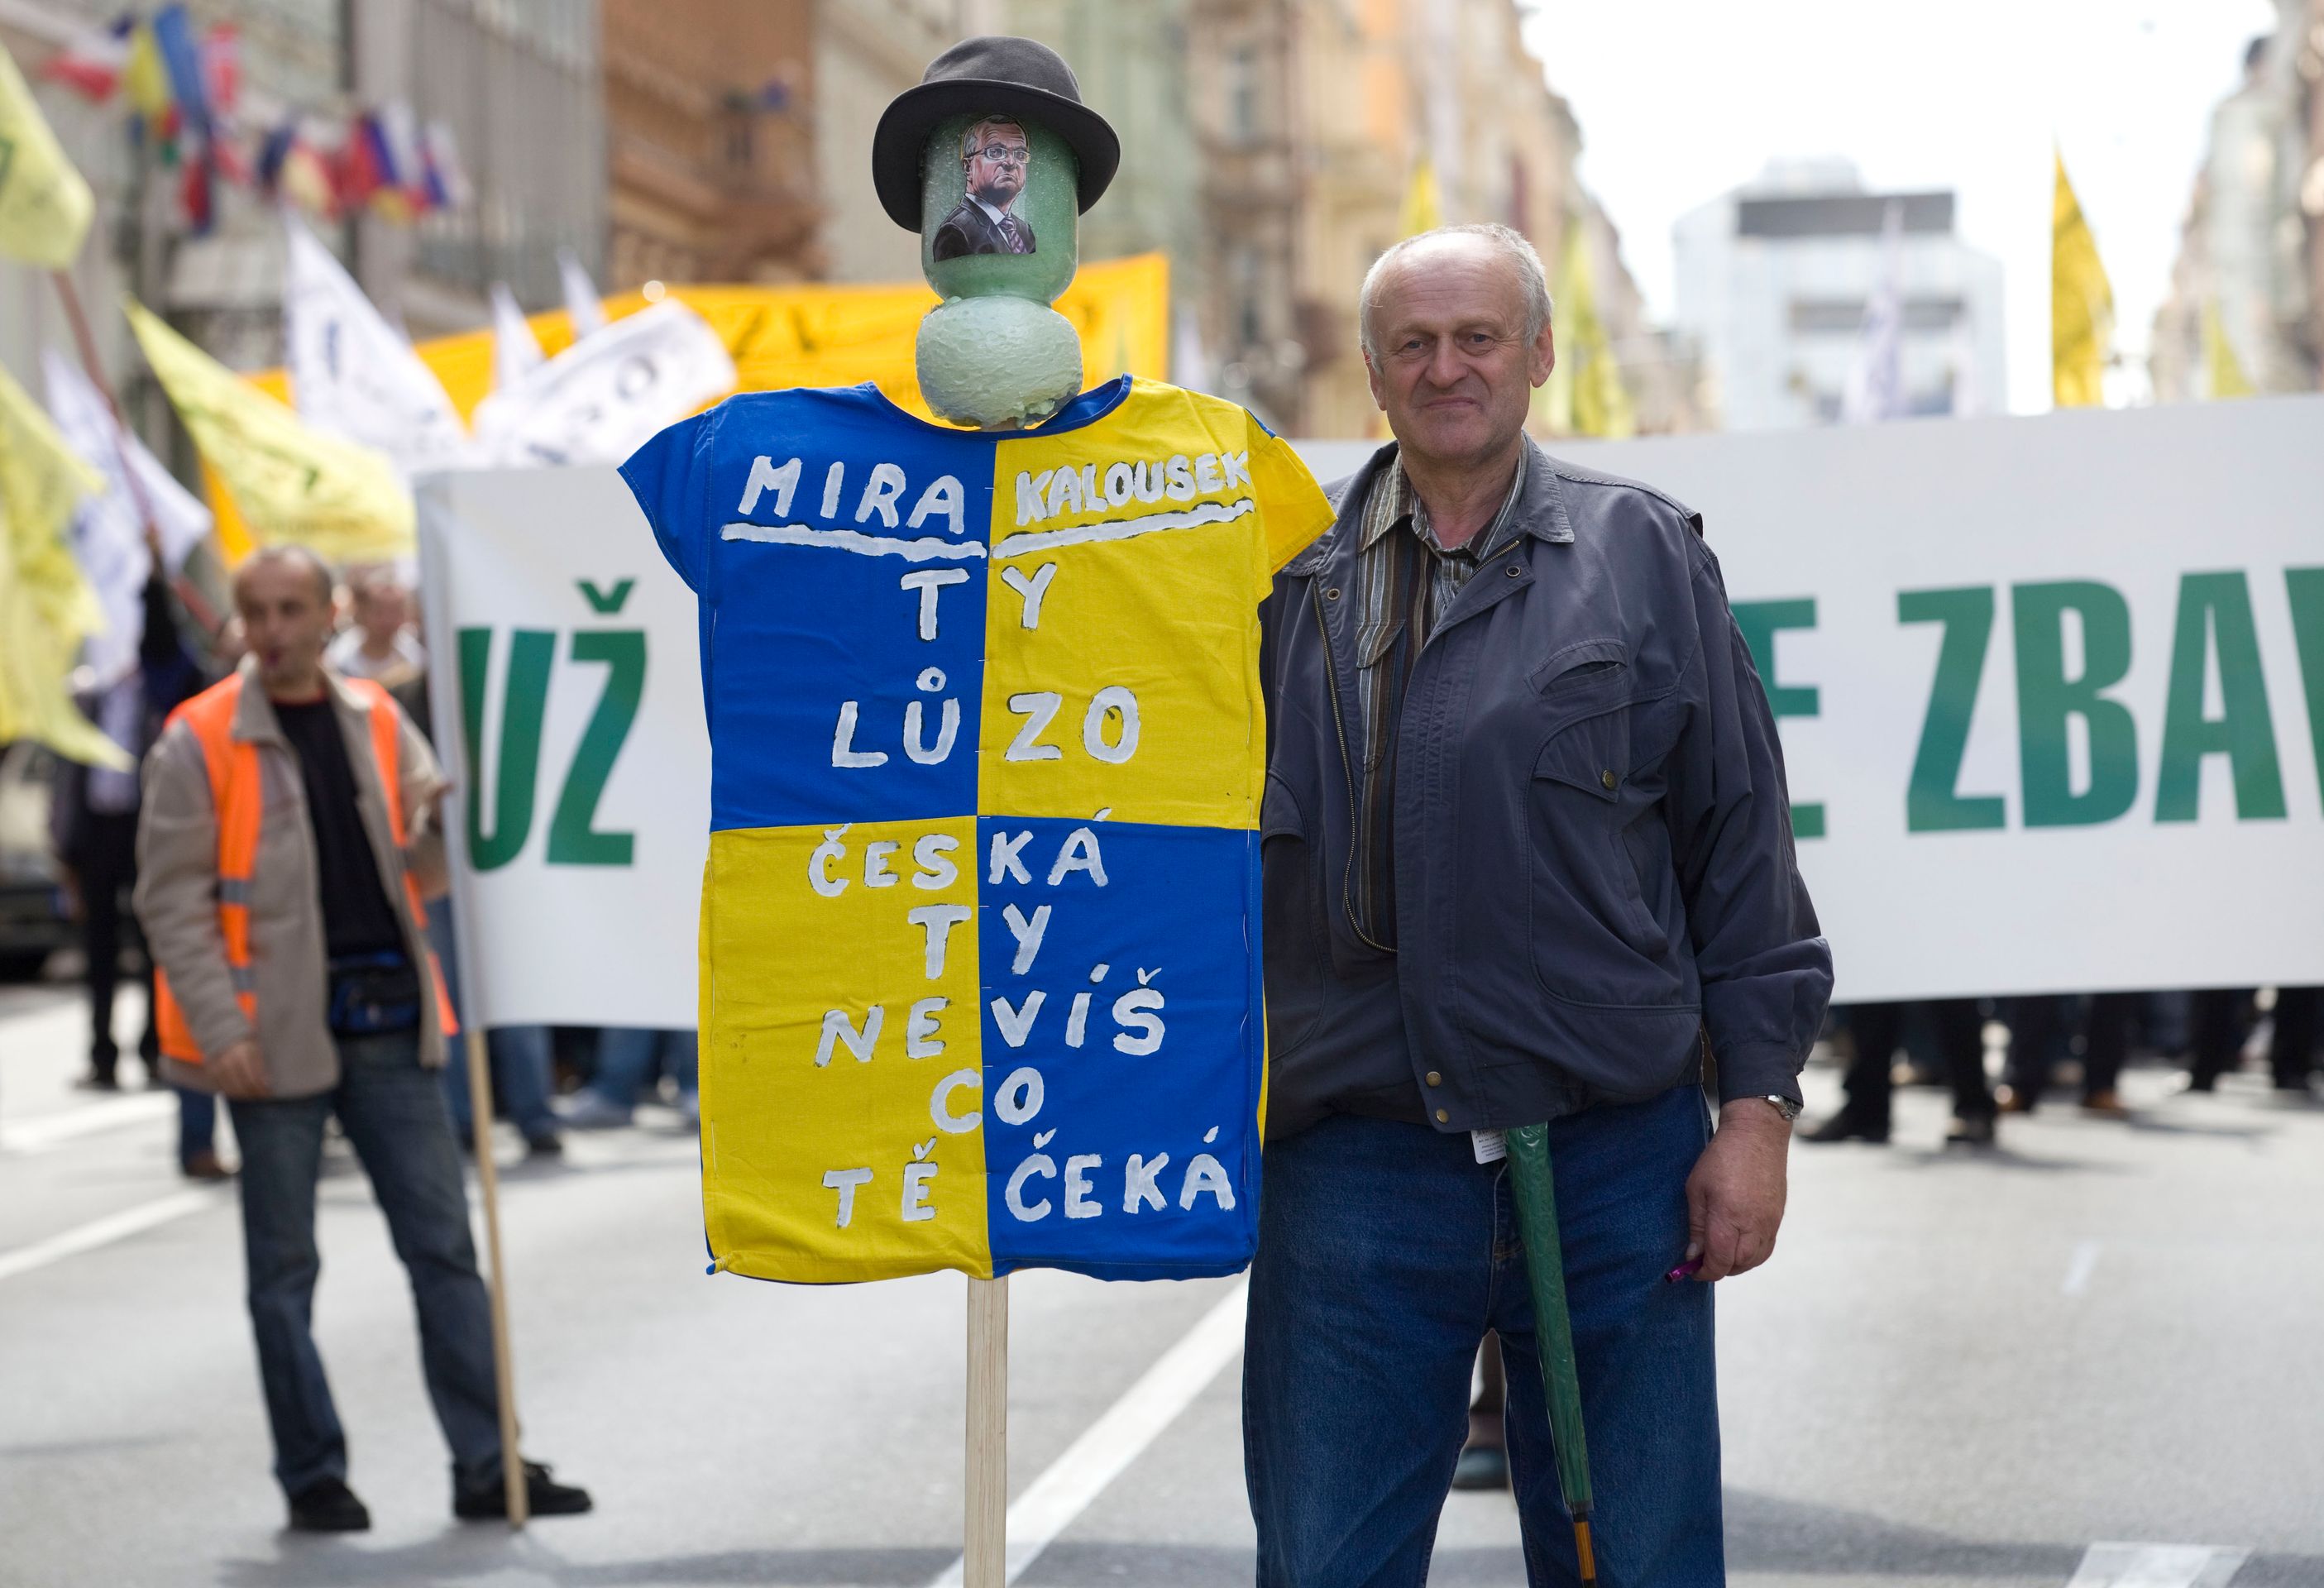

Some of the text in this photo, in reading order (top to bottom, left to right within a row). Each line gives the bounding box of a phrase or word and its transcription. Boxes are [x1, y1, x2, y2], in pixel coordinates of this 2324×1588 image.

[738, 450, 1251, 534] MIRA KALOUSEK
[457, 577, 647, 873] UŽ
[808, 807, 1109, 897] ČESKÁ
[930, 1067, 1045, 1134] CO
[822, 1126, 1236, 1228] TĚ ČEKÁ
